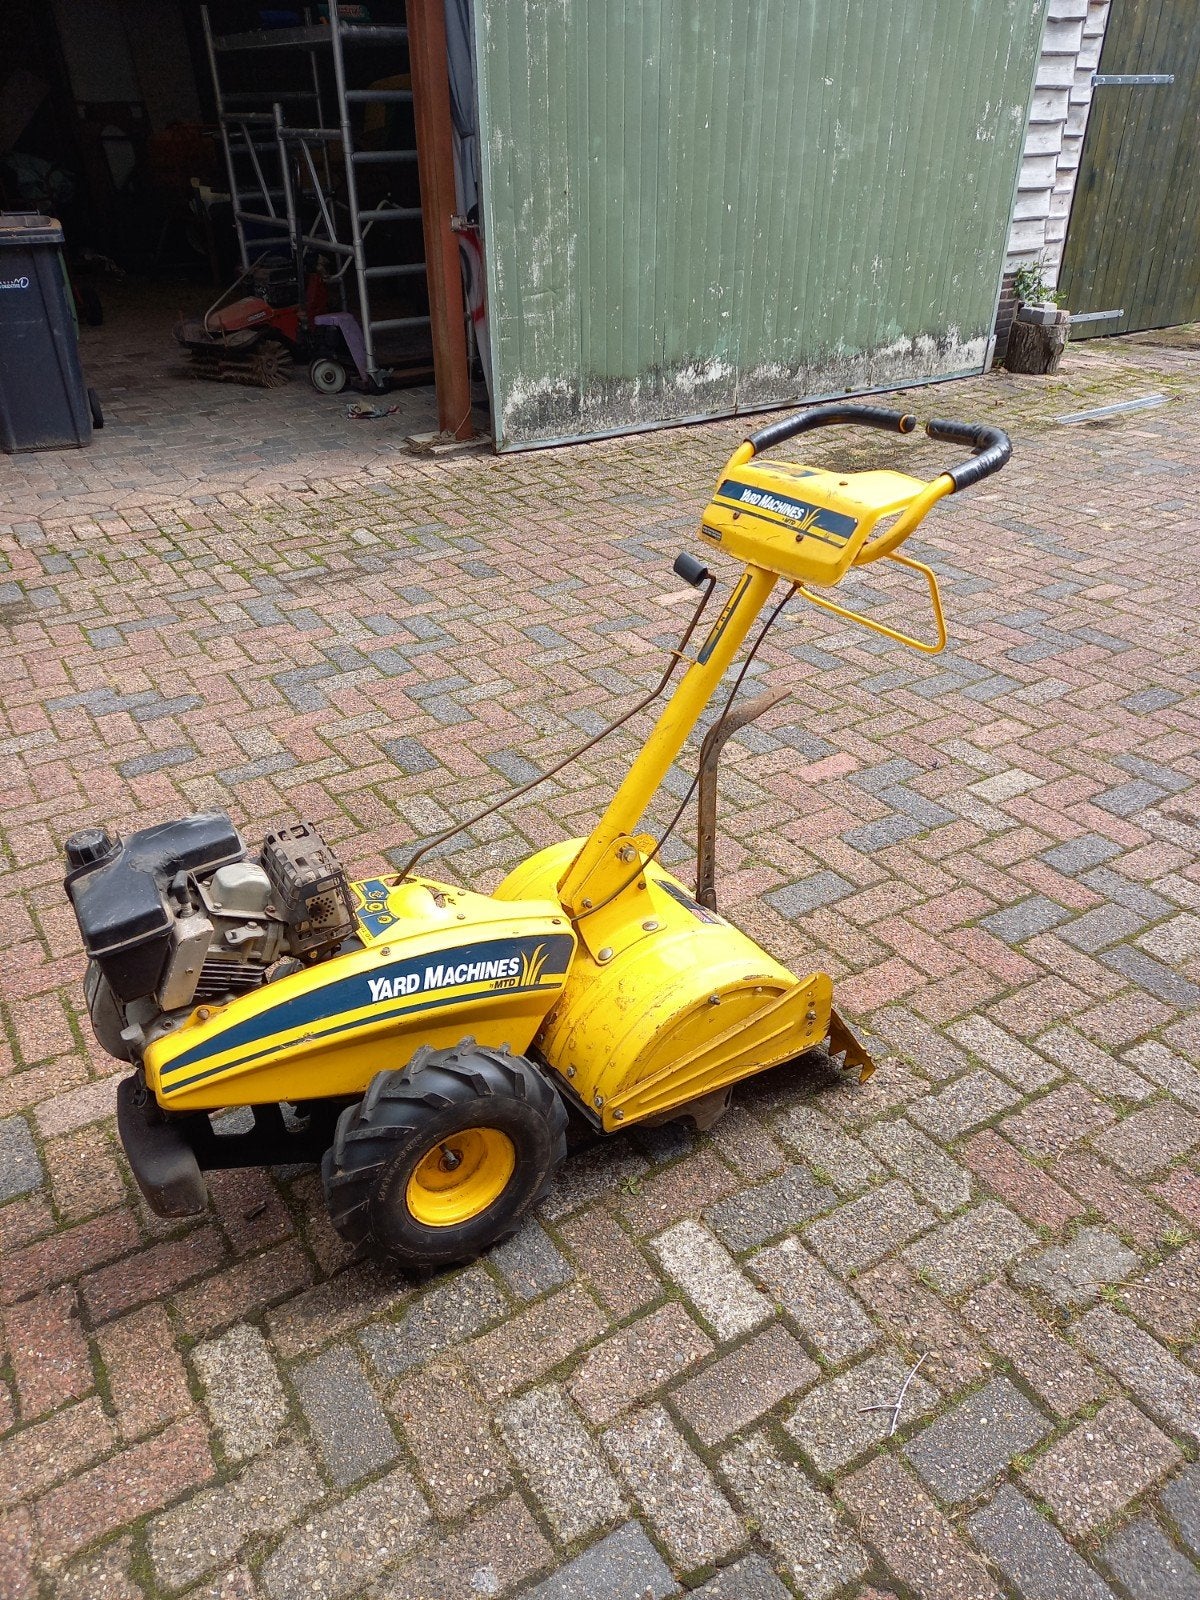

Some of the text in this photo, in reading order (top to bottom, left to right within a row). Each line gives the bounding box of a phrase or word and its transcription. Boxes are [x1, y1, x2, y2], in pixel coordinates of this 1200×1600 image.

[740, 488, 805, 519] YARD MACHINES
[367, 957, 520, 1002] YARD MACHINES
[494, 978, 516, 989] MTD
